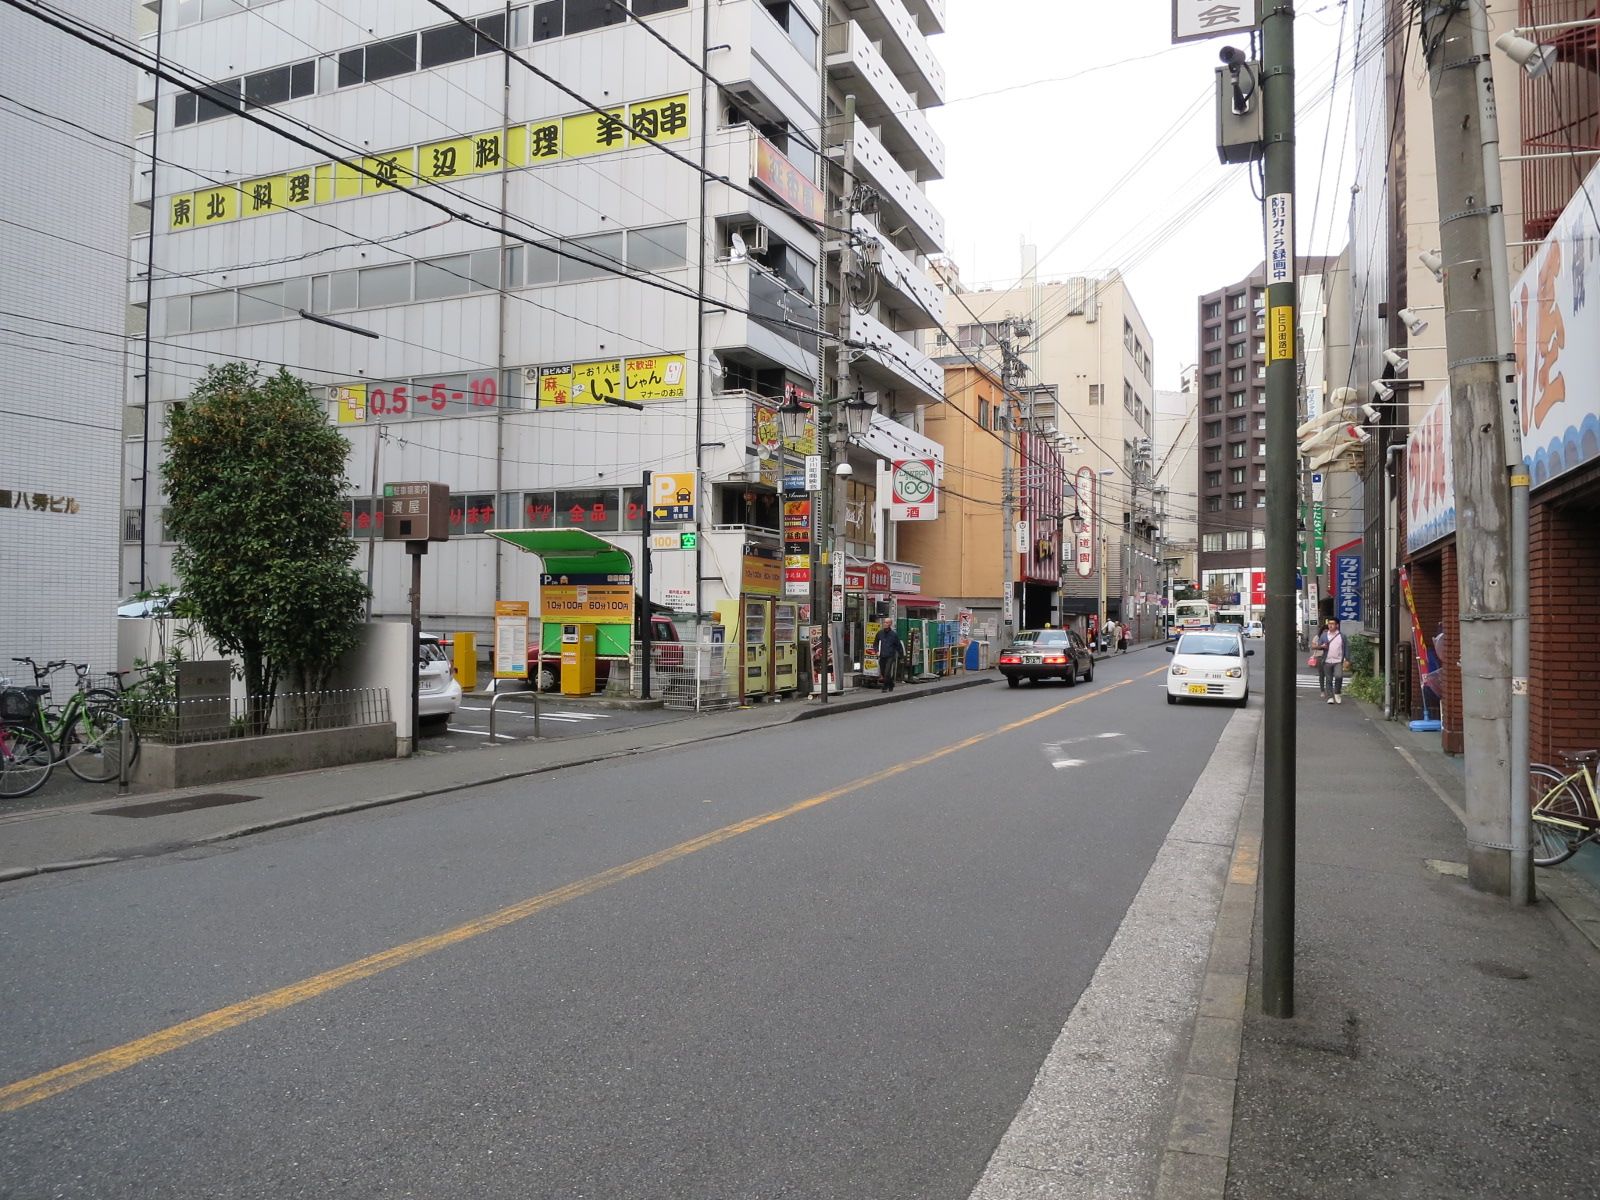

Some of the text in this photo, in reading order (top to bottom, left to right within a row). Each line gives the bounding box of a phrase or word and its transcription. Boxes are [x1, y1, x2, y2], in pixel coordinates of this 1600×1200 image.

[173, 173, 311, 226] 東北料理
[596, 101, 688, 146] 羊肉串
[1272, 197, 1287, 281] 防犯カメラ録画中
[544, 376, 568, 405] 麻雀
[655, 476, 676, 504] P
[898, 481, 930, 495] 100
[568, 503, 608, 522] 全品
[906, 506, 920, 518] 酒
